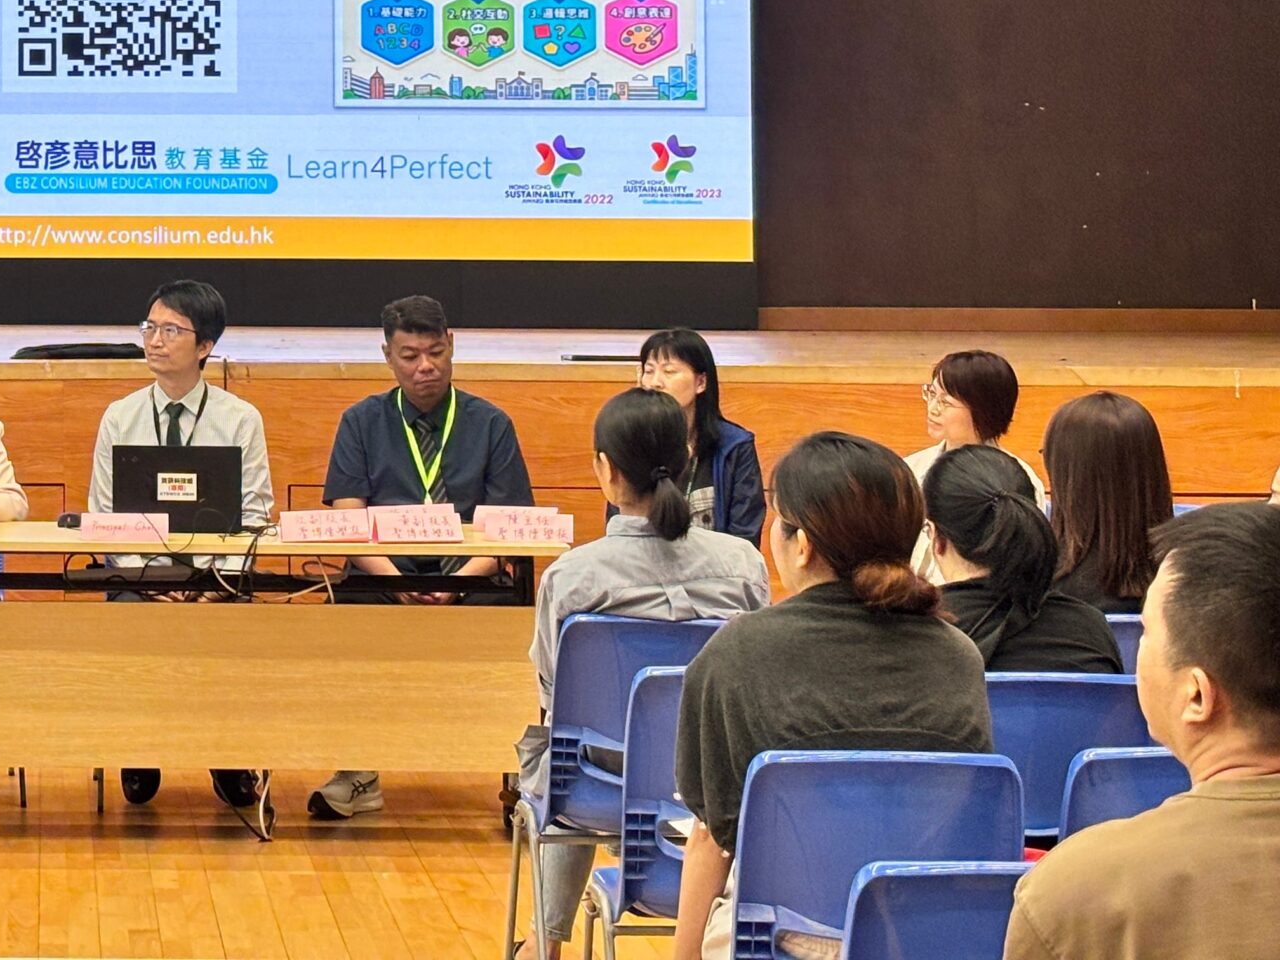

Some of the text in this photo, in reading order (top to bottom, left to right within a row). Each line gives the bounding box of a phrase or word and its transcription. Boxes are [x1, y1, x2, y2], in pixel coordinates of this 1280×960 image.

[164, 147, 270, 170] 教育基金
[287, 154, 493, 180] Learn4Perfect
[15, 177, 268, 190] EBZ CONSILIUM EDUCATION FOUNDATION
[584, 194, 614, 204] 2022
[695, 189, 722, 198] 2023
